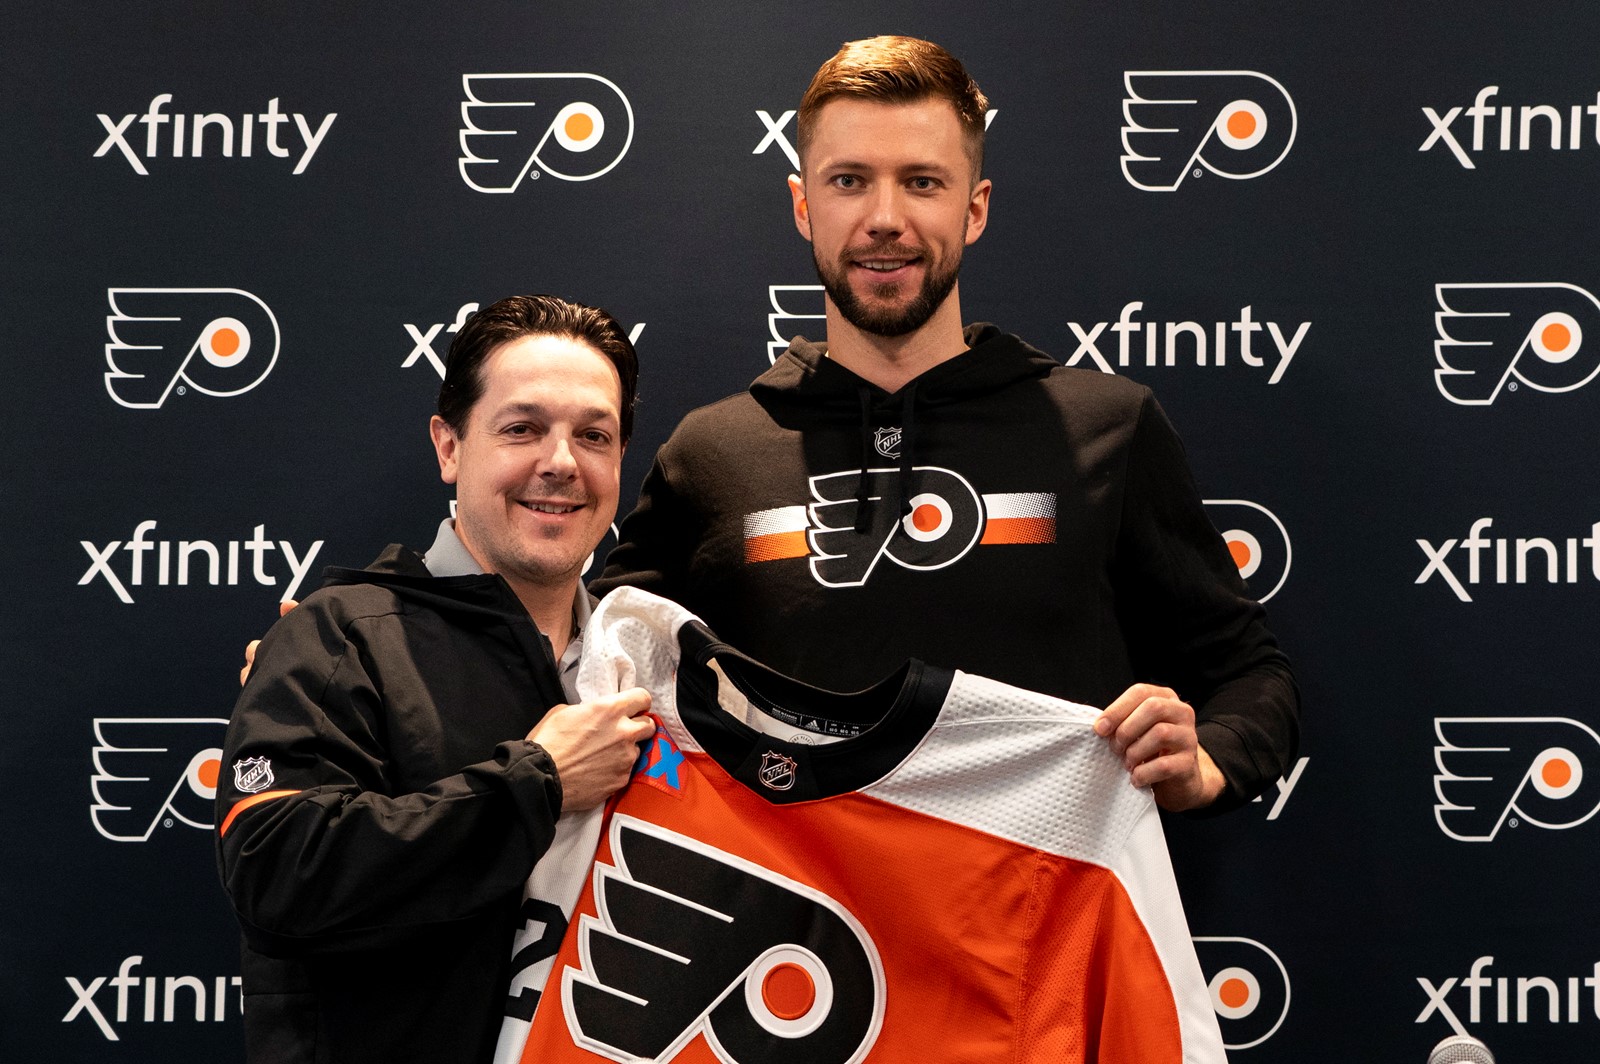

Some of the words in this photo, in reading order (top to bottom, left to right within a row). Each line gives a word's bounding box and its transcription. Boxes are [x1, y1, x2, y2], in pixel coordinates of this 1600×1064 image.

[92, 93, 338, 175] xfinity
[1064, 301, 1312, 385] xfinity
[77, 519, 325, 604] xfinity
